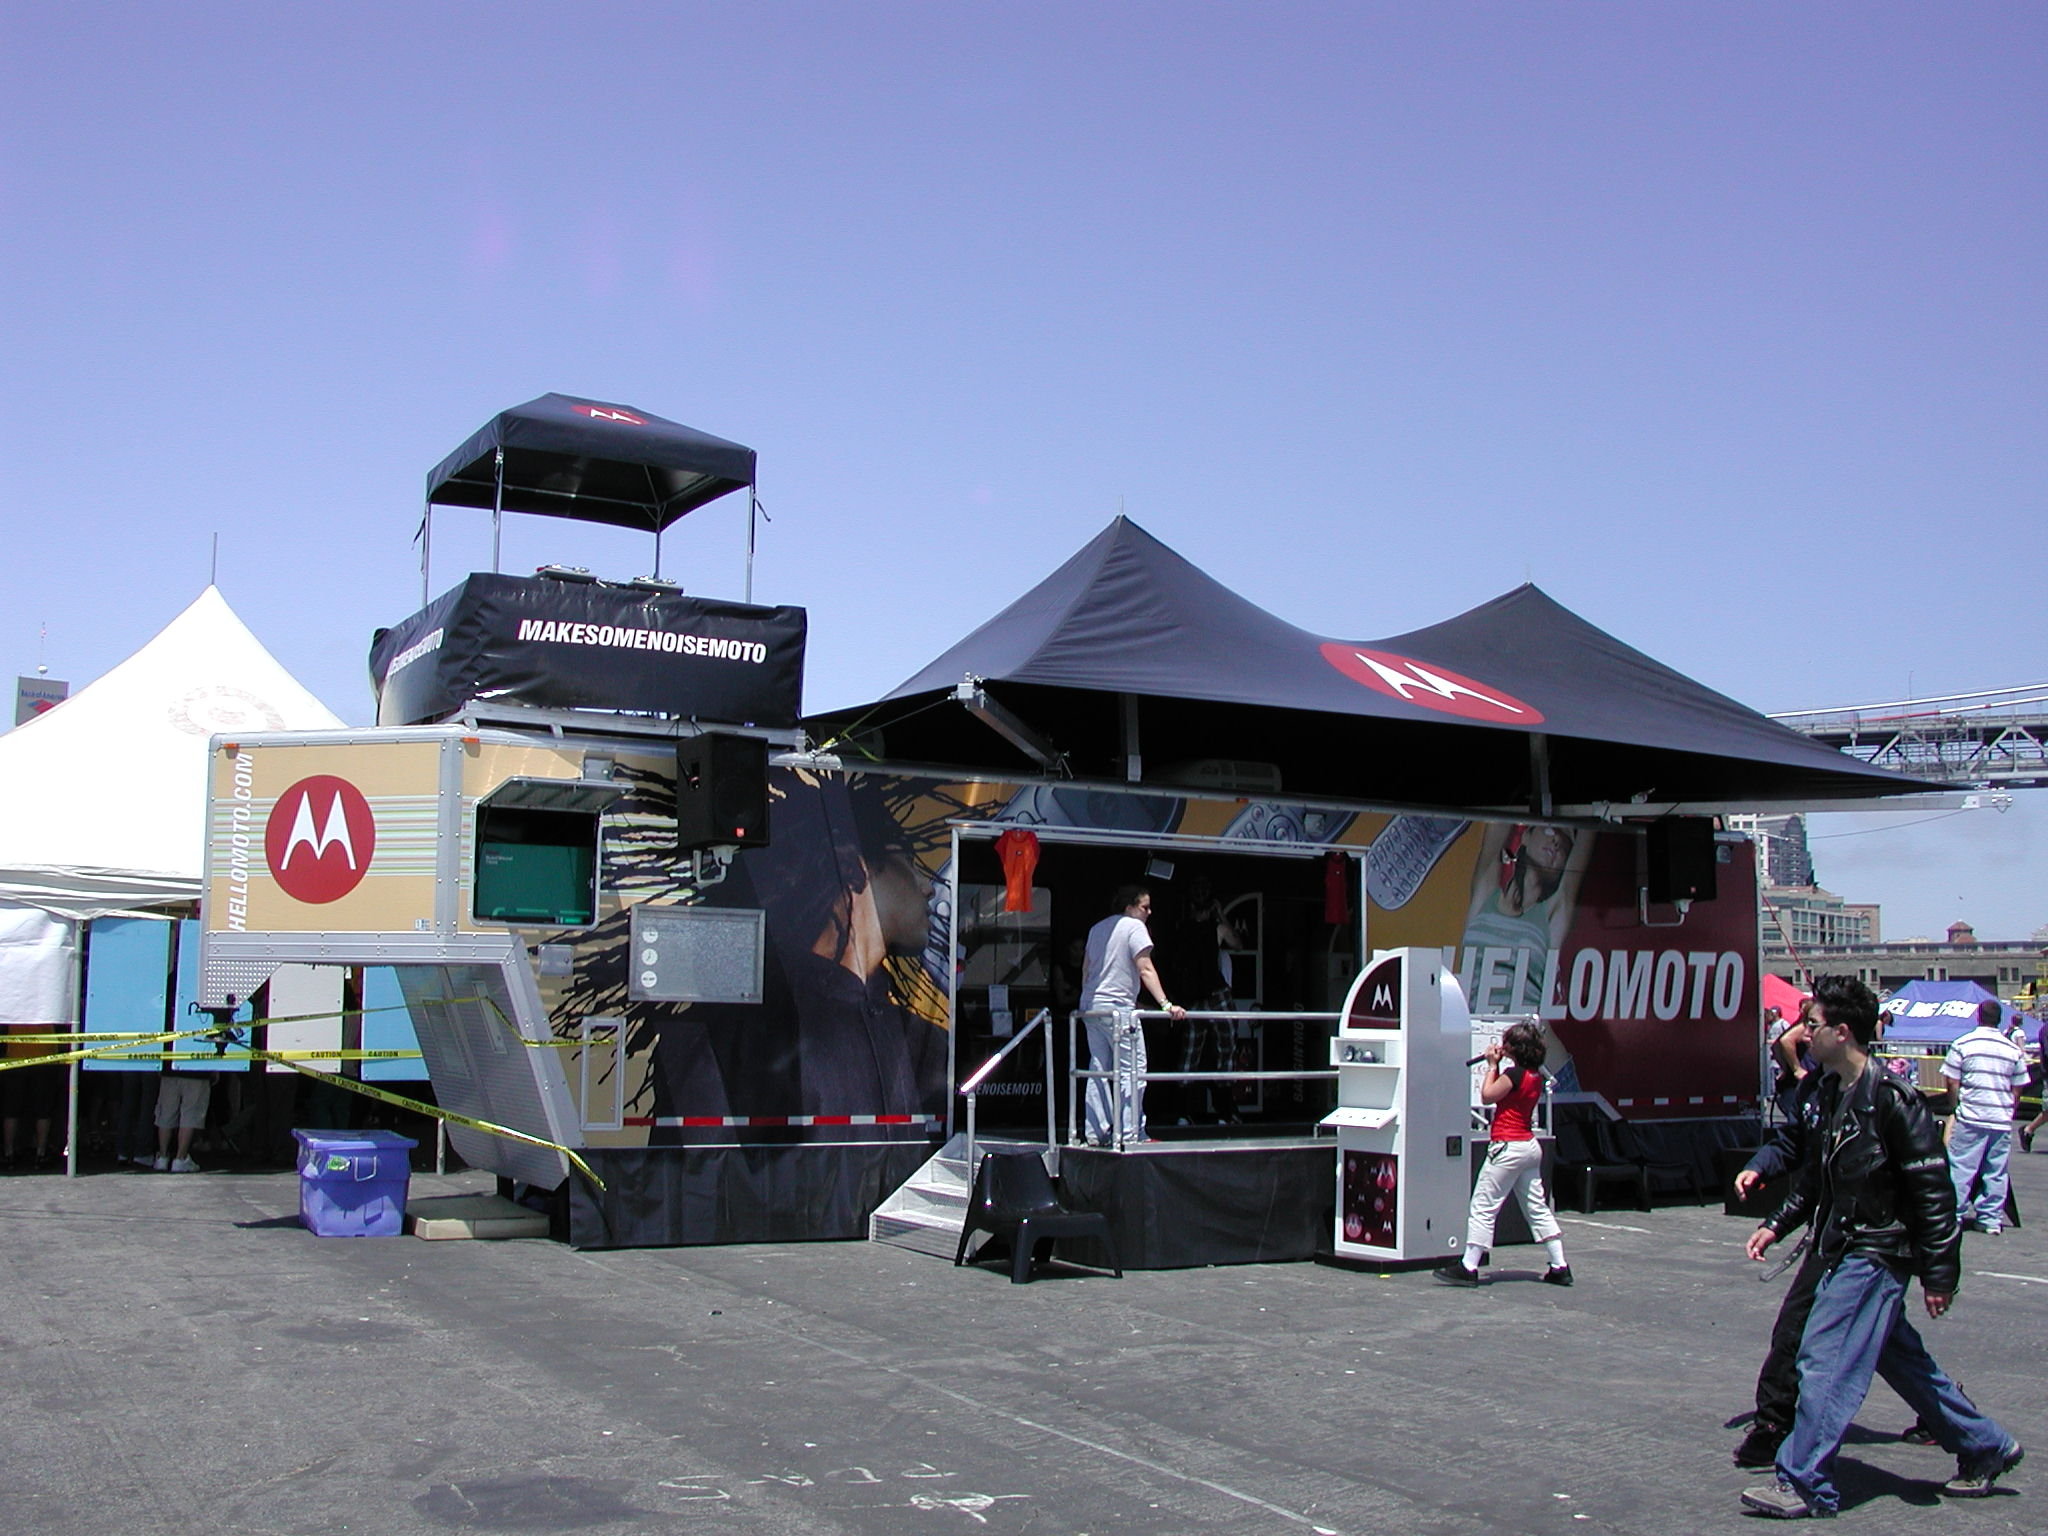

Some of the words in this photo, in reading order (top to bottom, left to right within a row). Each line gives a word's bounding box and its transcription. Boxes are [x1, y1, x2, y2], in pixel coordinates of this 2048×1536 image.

[517, 619, 767, 664] MAKESOMENOISEMOTO
[228, 753, 254, 932] HELLOMOTO.COM
[1443, 946, 1745, 1021] HELLOMOTO
[311, 1051, 342, 1059] CAUTION
[368, 1050, 399, 1058] CAUTION
